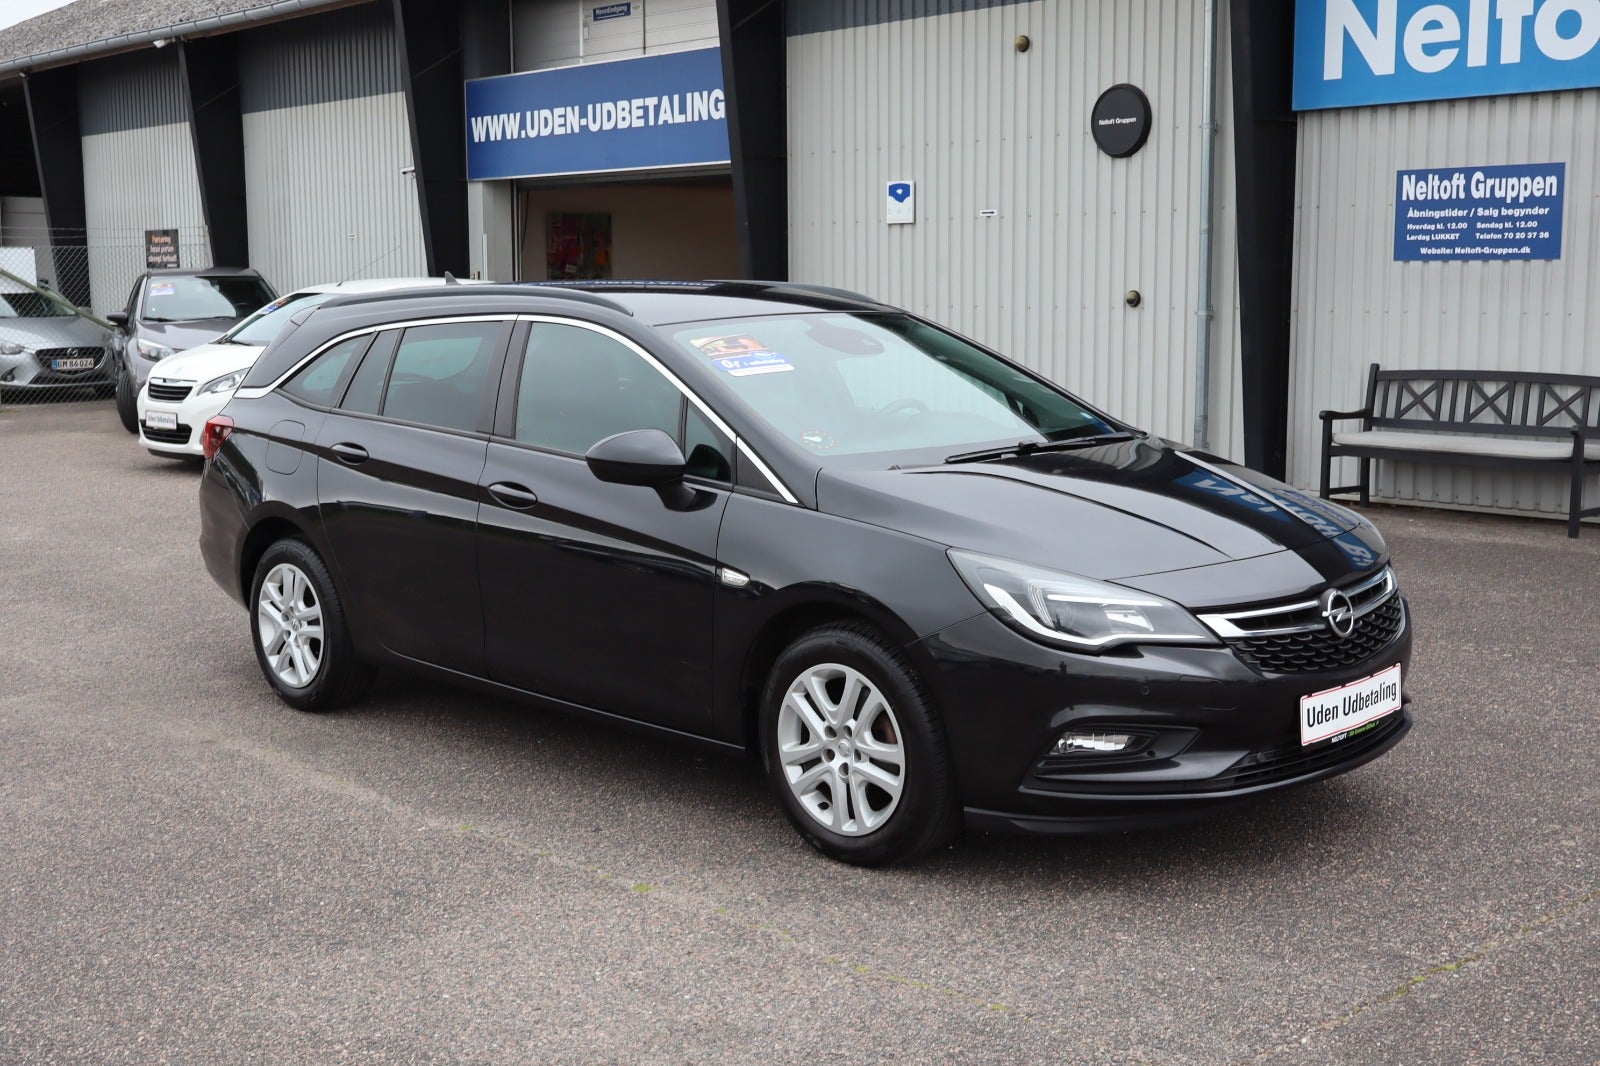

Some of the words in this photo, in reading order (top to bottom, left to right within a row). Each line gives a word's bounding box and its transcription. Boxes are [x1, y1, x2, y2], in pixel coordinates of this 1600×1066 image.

[471, 88, 726, 143] WWW.UDEN-UDBETALING
[1099, 118, 1115, 126] Neltoft
[1402, 172, 1466, 201] Neltoft
[1470, 171, 1557, 204] Gruppen
[1407, 206, 1468, 219] Åbningstider
[1469, 208, 1475, 218] /
[1476, 207, 1499, 217] Salg
[1501, 206, 1550, 217] begynder
[1406, 233, 1430, 241] Lørdag
[1454, 246, 1531, 255] Neltoft-Gruppen.dk
[1306, 704, 1339, 728] Uden
[1342, 682, 1397, 717] Udbetaling
